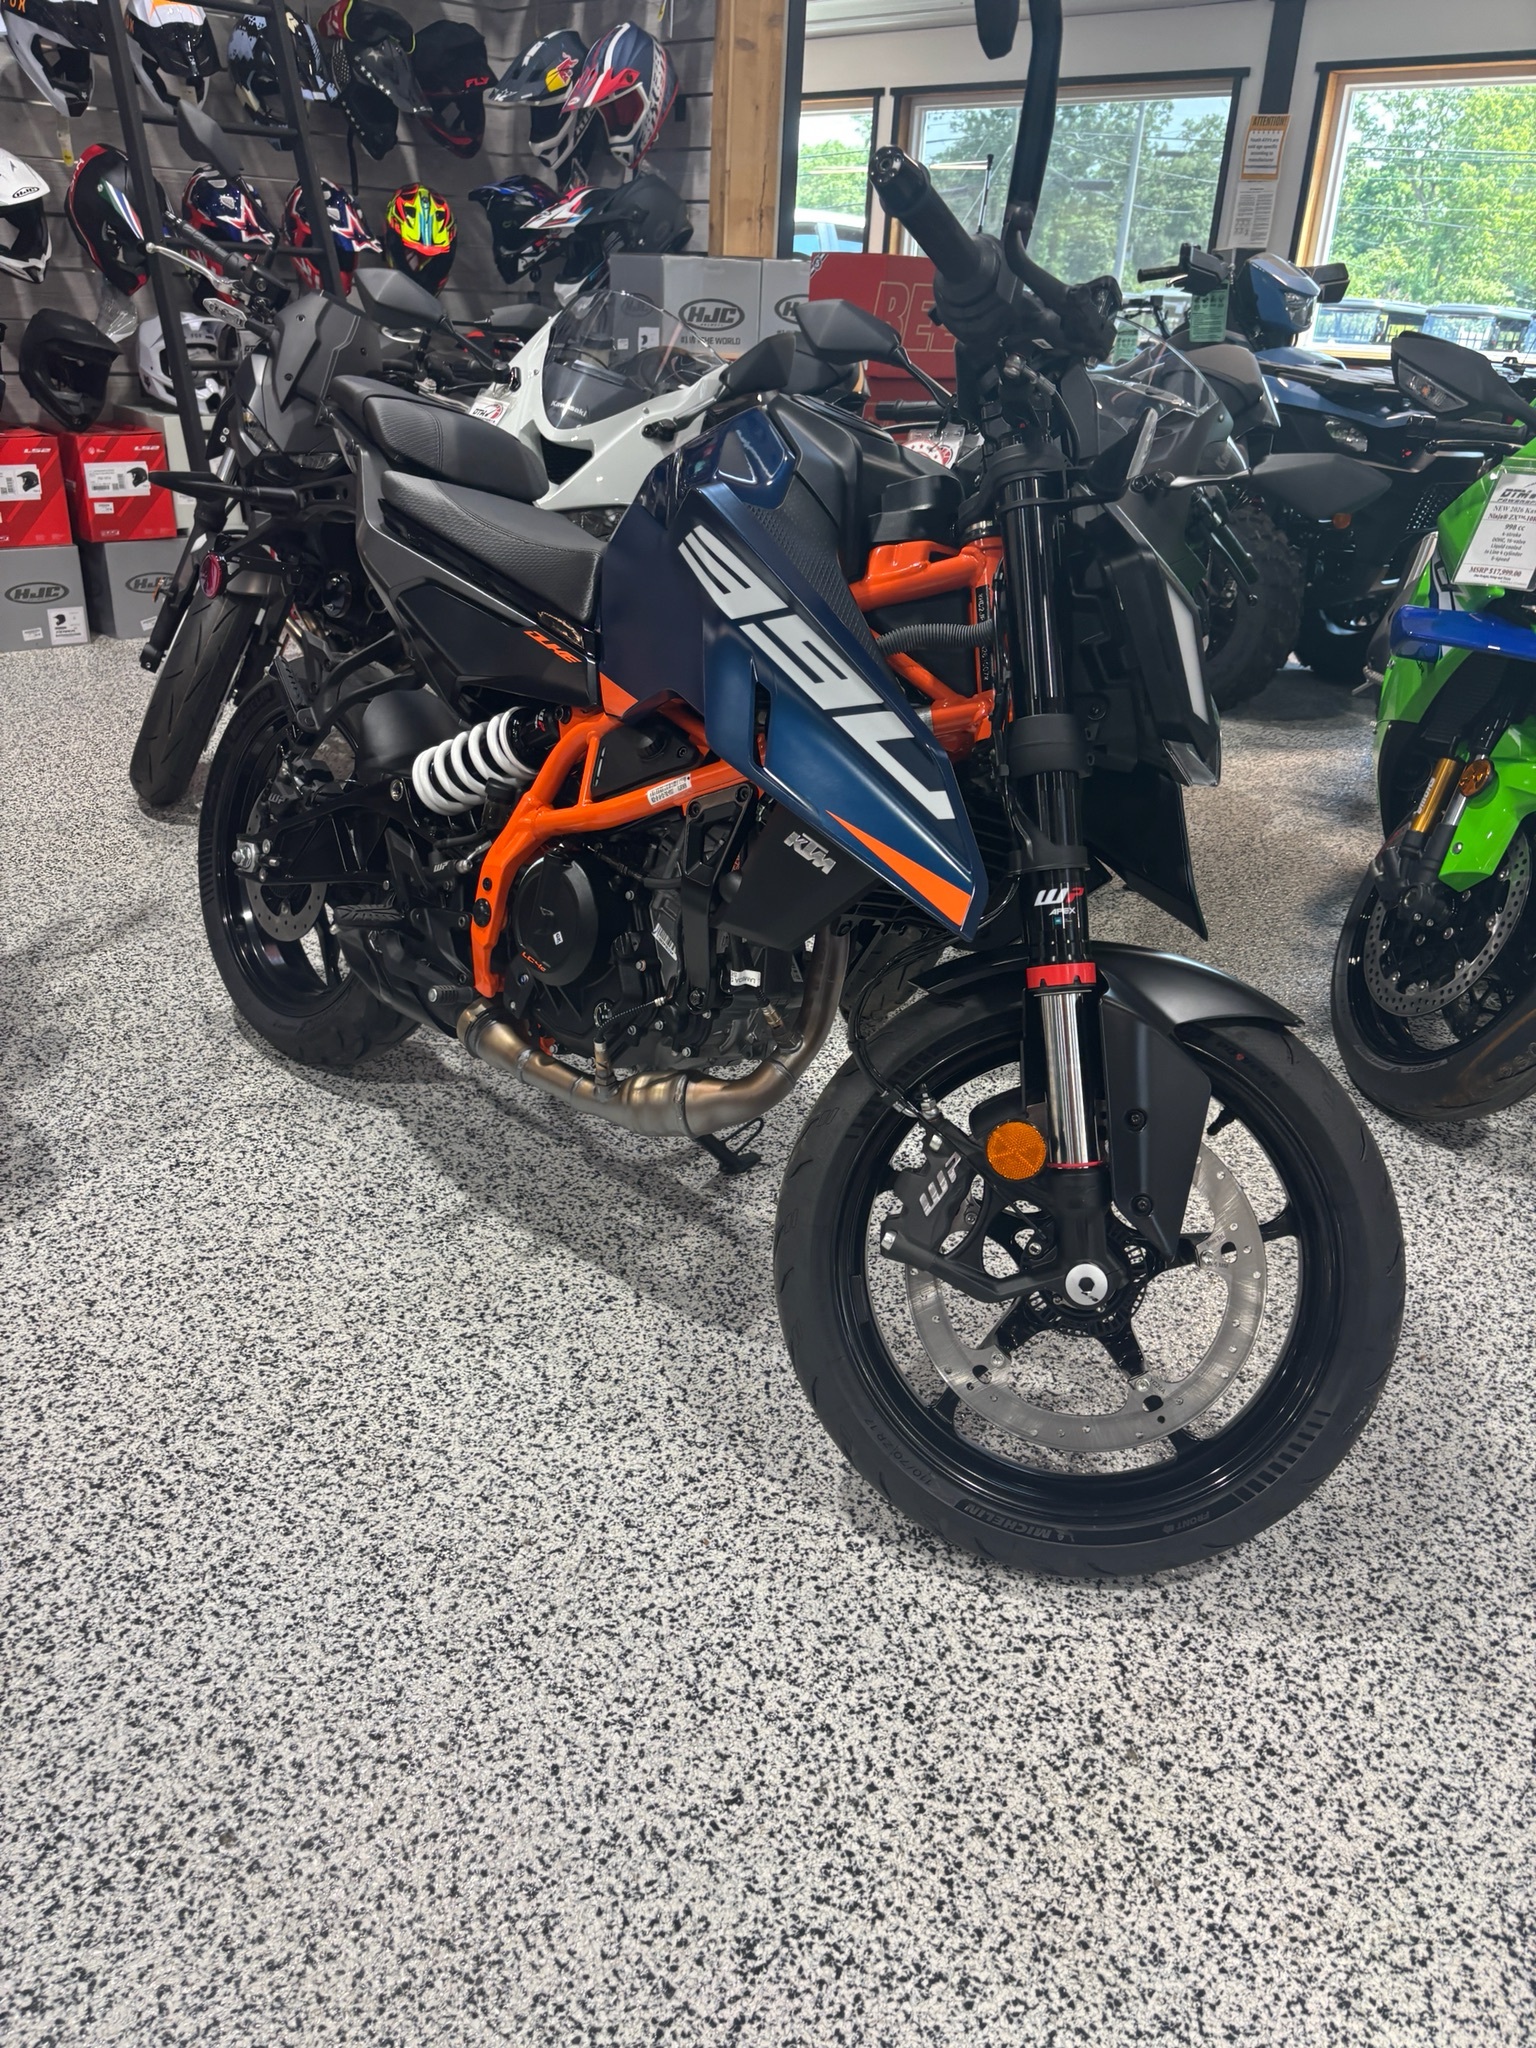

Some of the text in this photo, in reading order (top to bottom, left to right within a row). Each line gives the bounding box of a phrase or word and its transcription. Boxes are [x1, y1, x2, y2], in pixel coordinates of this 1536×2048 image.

[465, 76, 489, 88] FLY
[688, 306, 737, 323] HJC
[715, 337, 741, 345] WORLD
[551, 401, 587, 417] Kawasaki
[1469, 566, 1489, 574] MSRP
[14, 586, 60, 599] HJC
[523, 628, 582, 664] DUKE
[783, 831, 837, 875] KTM
[1034, 886, 1085, 906] WP
[1049, 906, 1076, 916] APEX
[919, 1151, 962, 1217] WP
[864, 1417, 932, 1486] 110/70 ZR 17
[963, 1502, 1052, 1540] MICHELIN
[1176, 1511, 1211, 1533] FRONT
